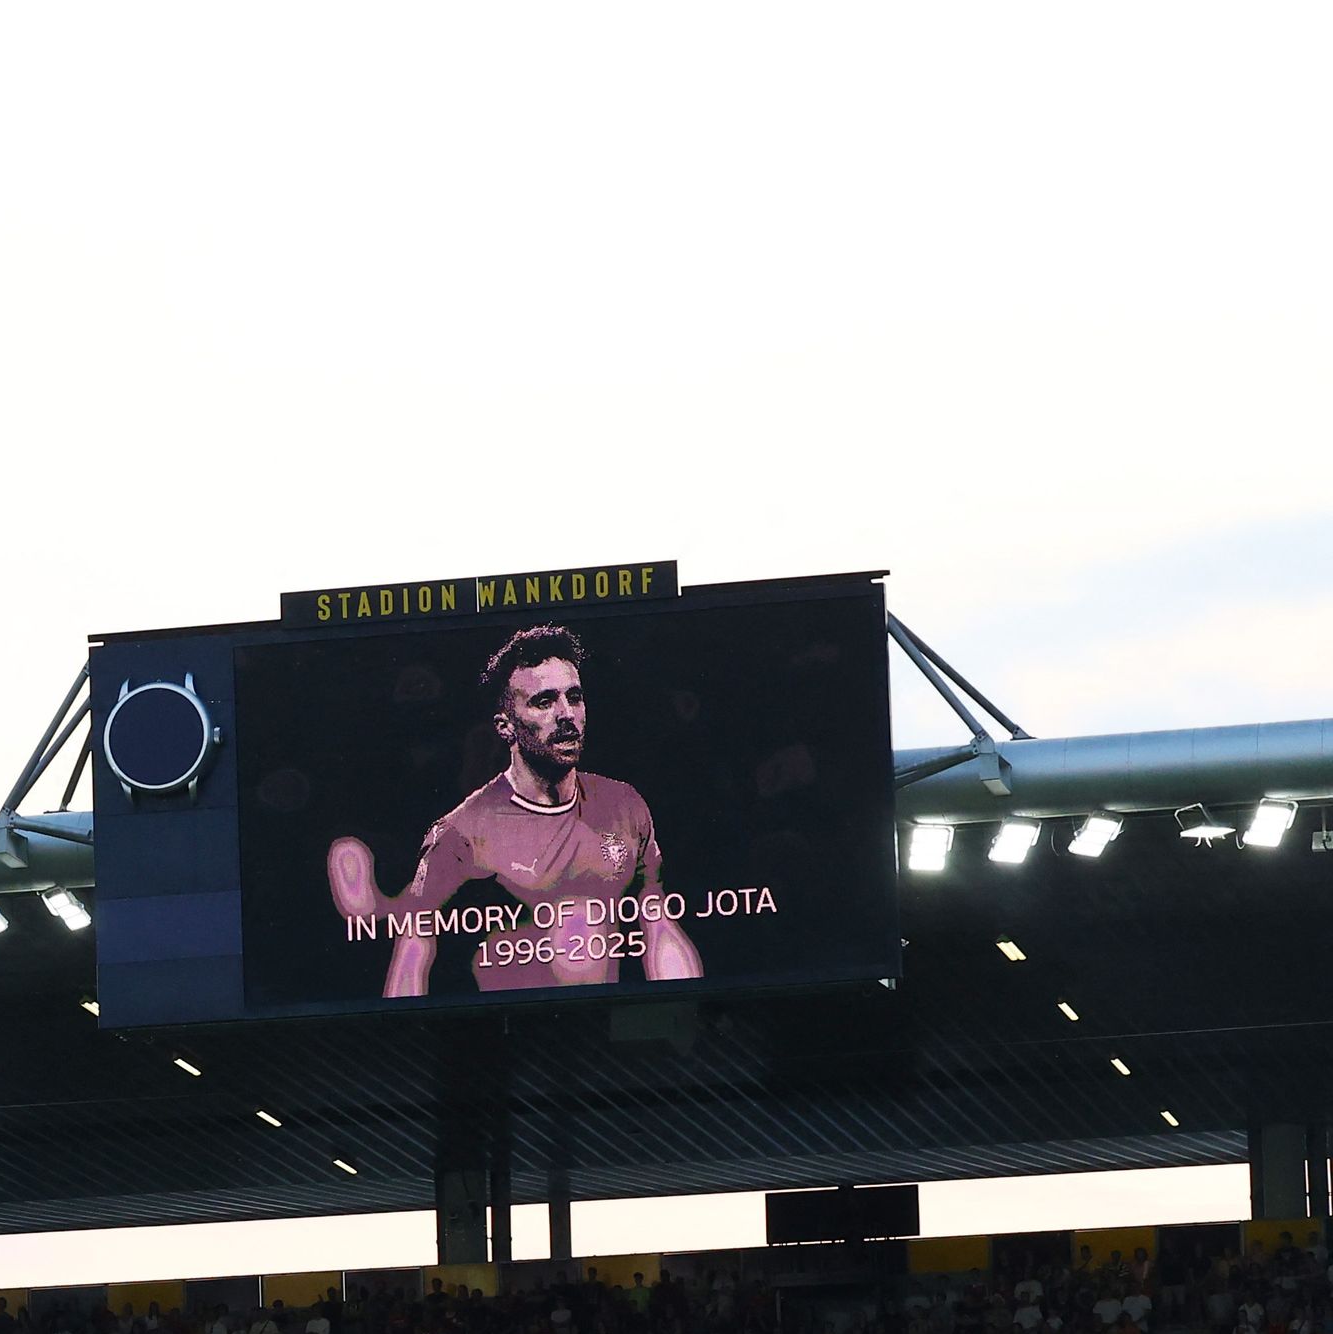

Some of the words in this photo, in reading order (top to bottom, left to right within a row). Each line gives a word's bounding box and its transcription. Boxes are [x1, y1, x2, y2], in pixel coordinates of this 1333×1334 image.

[317, 584, 456, 621] STADION
[479, 567, 654, 607] WANKDORF
[346, 914, 377, 941] IN
[387, 903, 524, 940] MEMORY
[532, 900, 575, 929] OF
[586, 892, 686, 926] DIOGO
[695, 886, 778, 918] JOTA
[477, 930, 647, 967] 1996-2025
